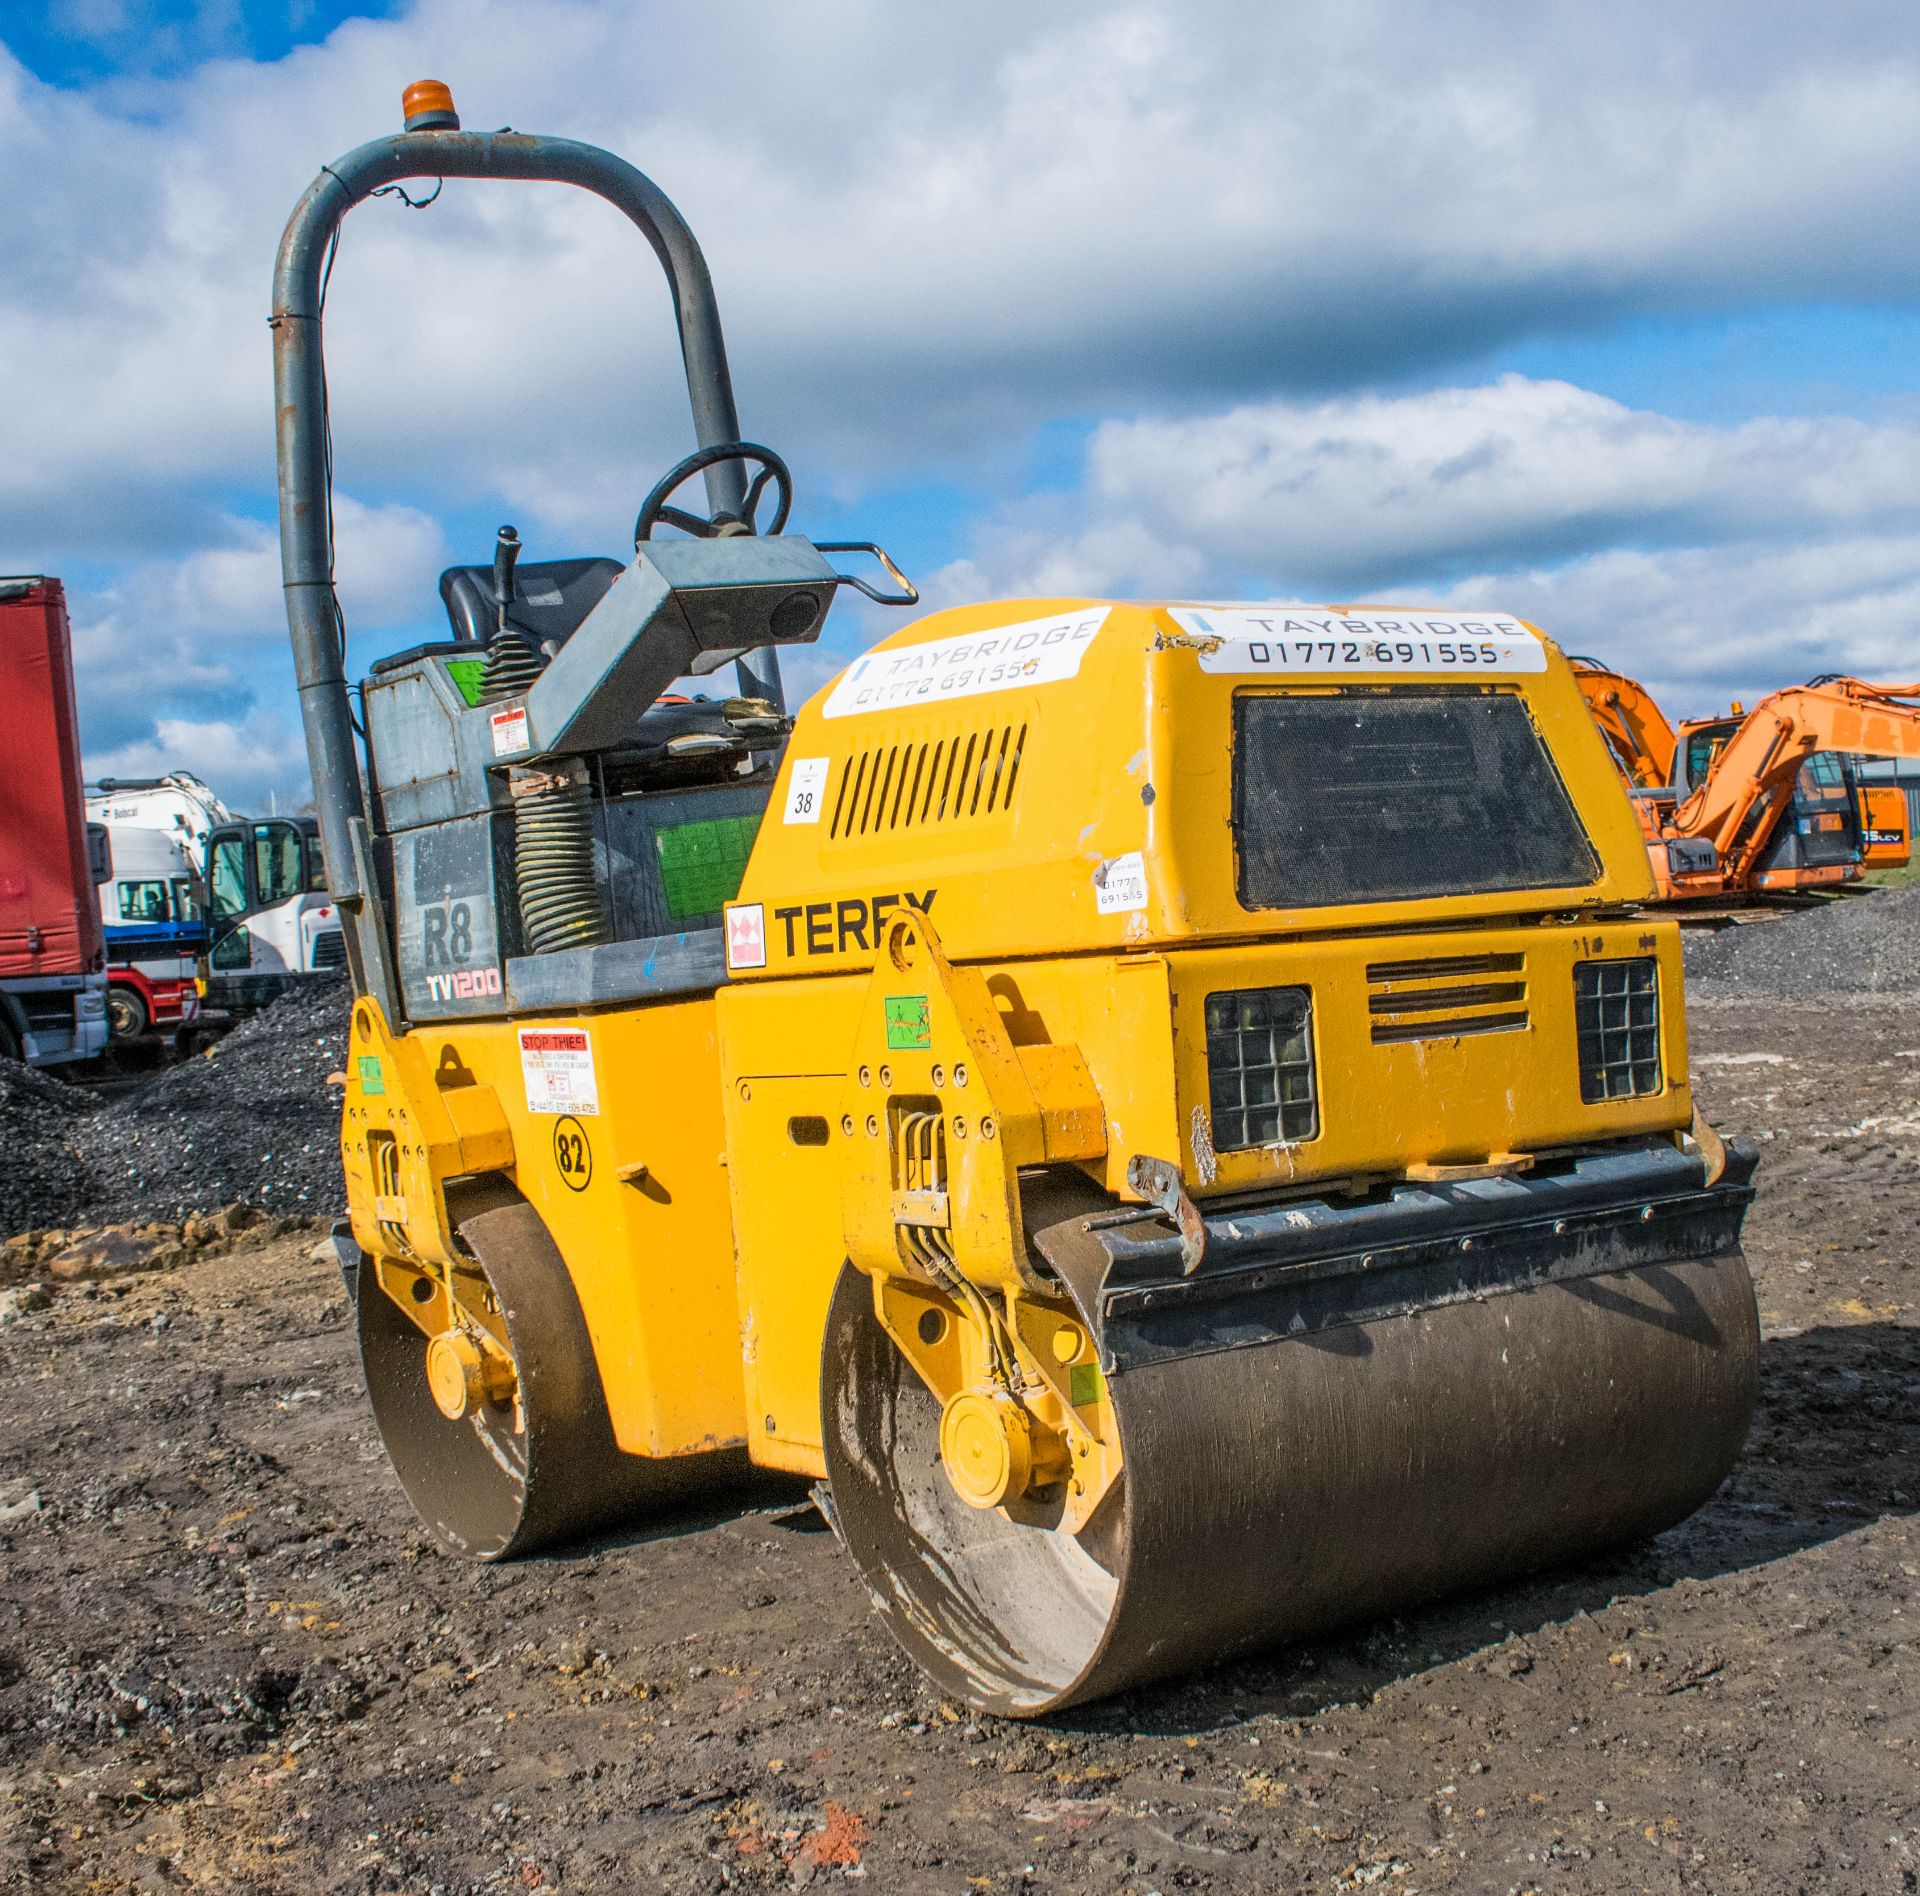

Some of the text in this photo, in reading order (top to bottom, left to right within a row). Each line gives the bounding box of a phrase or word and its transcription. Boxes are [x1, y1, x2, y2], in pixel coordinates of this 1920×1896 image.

[1245, 618, 1525, 636] TAYBRIDGE
[886, 619, 1100, 677] TAYBRIDGE
[1249, 642, 1499, 664] 01772 691555
[852, 657, 1040, 706] 01772 691555
[113, 807, 138, 819] Bobcat
[794, 792, 814, 814] 38
[424, 902, 473, 967] R8
[426, 967, 502, 1002] TV1200
[522, 1036, 586, 1049] STOP THIEF!
[557, 1133, 586, 1174] 82
